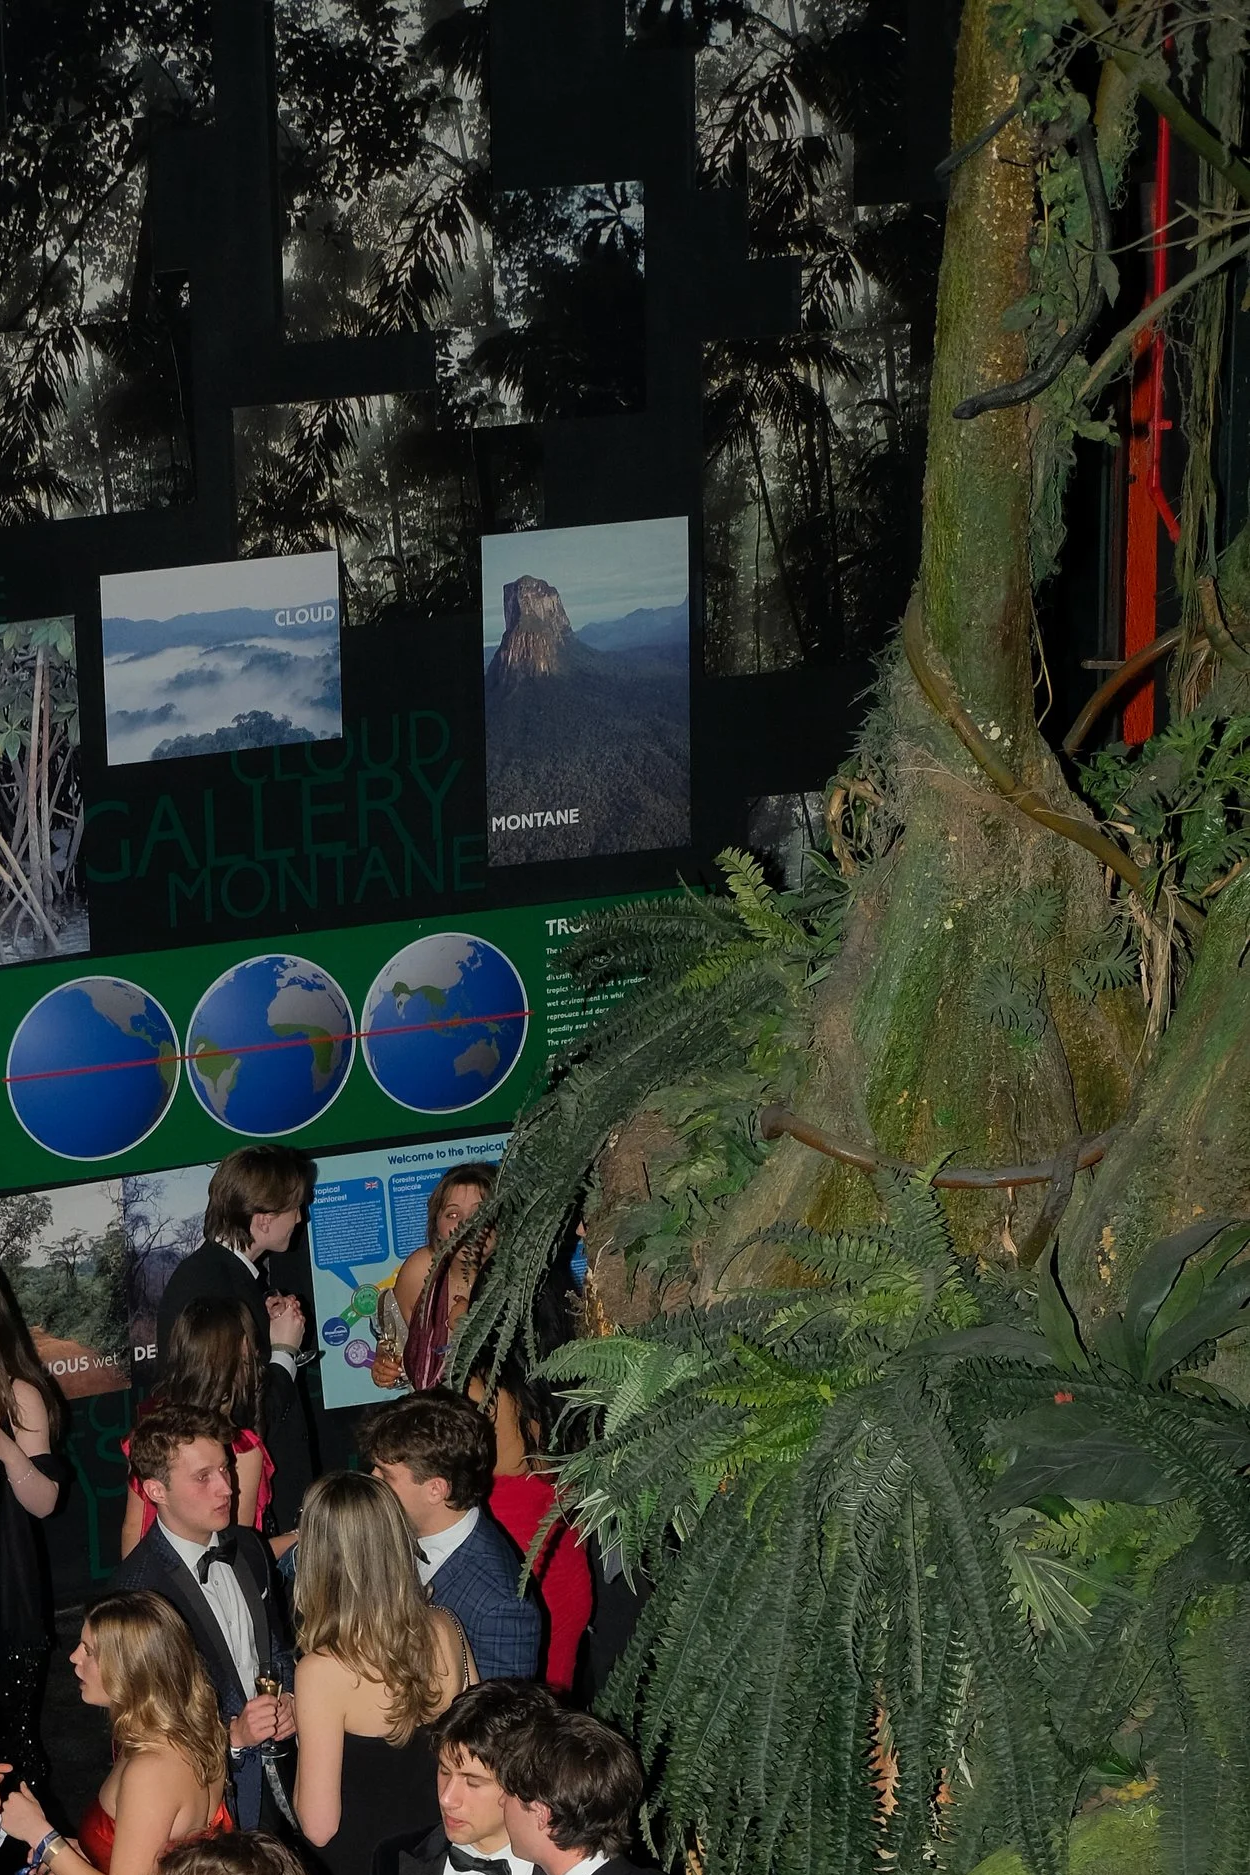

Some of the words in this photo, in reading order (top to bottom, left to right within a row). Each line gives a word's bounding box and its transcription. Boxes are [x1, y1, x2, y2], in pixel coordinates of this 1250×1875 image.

[275, 605, 336, 627] CLOUD
[86, 759, 464, 884] GALLERY
[492, 808, 579, 832] MONTANE
[168, 834, 486, 928] MONTANE
[387, 1152, 434, 1165] Welcome
[436, 1149, 446, 1159] to
[448, 1147, 464, 1157] the
[466, 1141, 504, 1155] Tropical
[392, 1176, 415, 1185] Foresta
[392, 1183, 422, 1193] tropicale
[92, 1351, 120, 1369] wet
